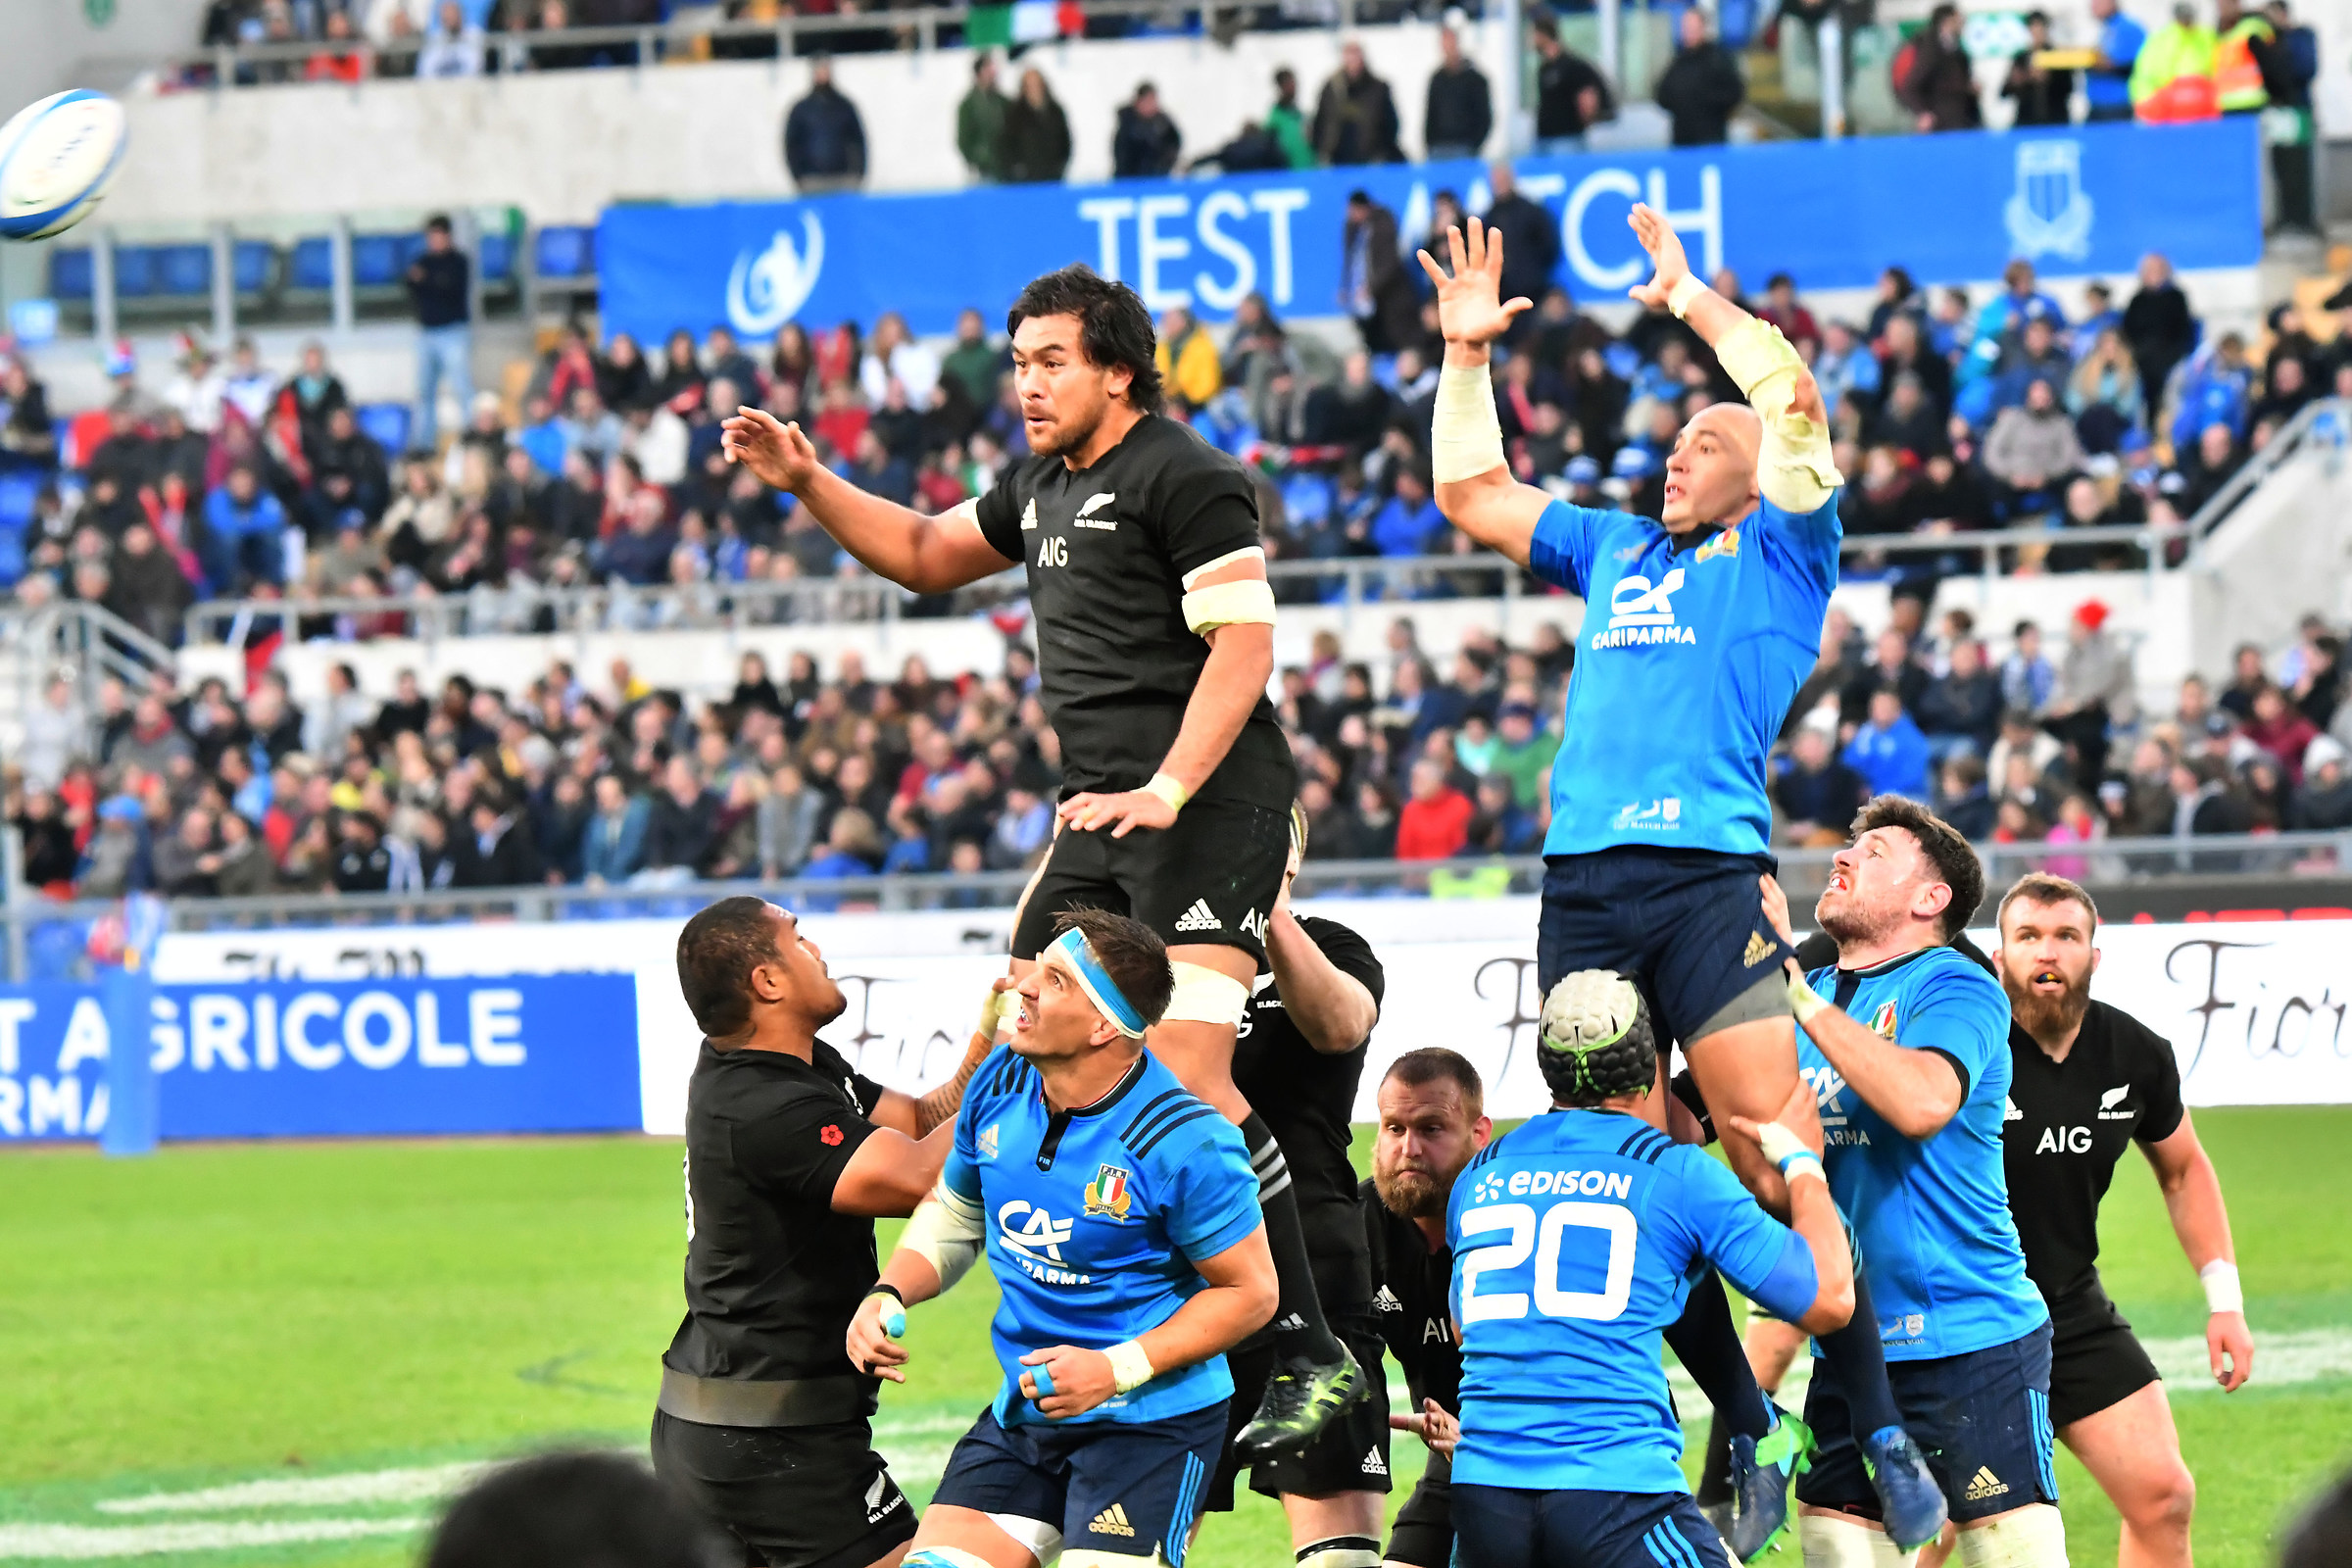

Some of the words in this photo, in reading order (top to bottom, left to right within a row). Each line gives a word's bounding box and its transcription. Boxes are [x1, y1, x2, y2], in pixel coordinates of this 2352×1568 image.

[1080, 189, 1309, 312] TEST
[1038, 536, 1068, 567] AIG
[1592, 625, 1696, 650] CARIPARMA
[1175, 918, 1222, 932] adidas
[1256, 1000, 1285, 1009] BLACK
[57, 989, 527, 1075] AGRICOLE
[2035, 1125, 2092, 1155] AIG
[1038, 1156, 1052, 1166] FIR
[1460, 1201, 1639, 1325] 20
[1423, 1317, 1449, 1346] AI
[1361, 1463, 1388, 1476] adidas
[1965, 1482, 2010, 1501] adidas
[1089, 1522, 1136, 1538] adidas
